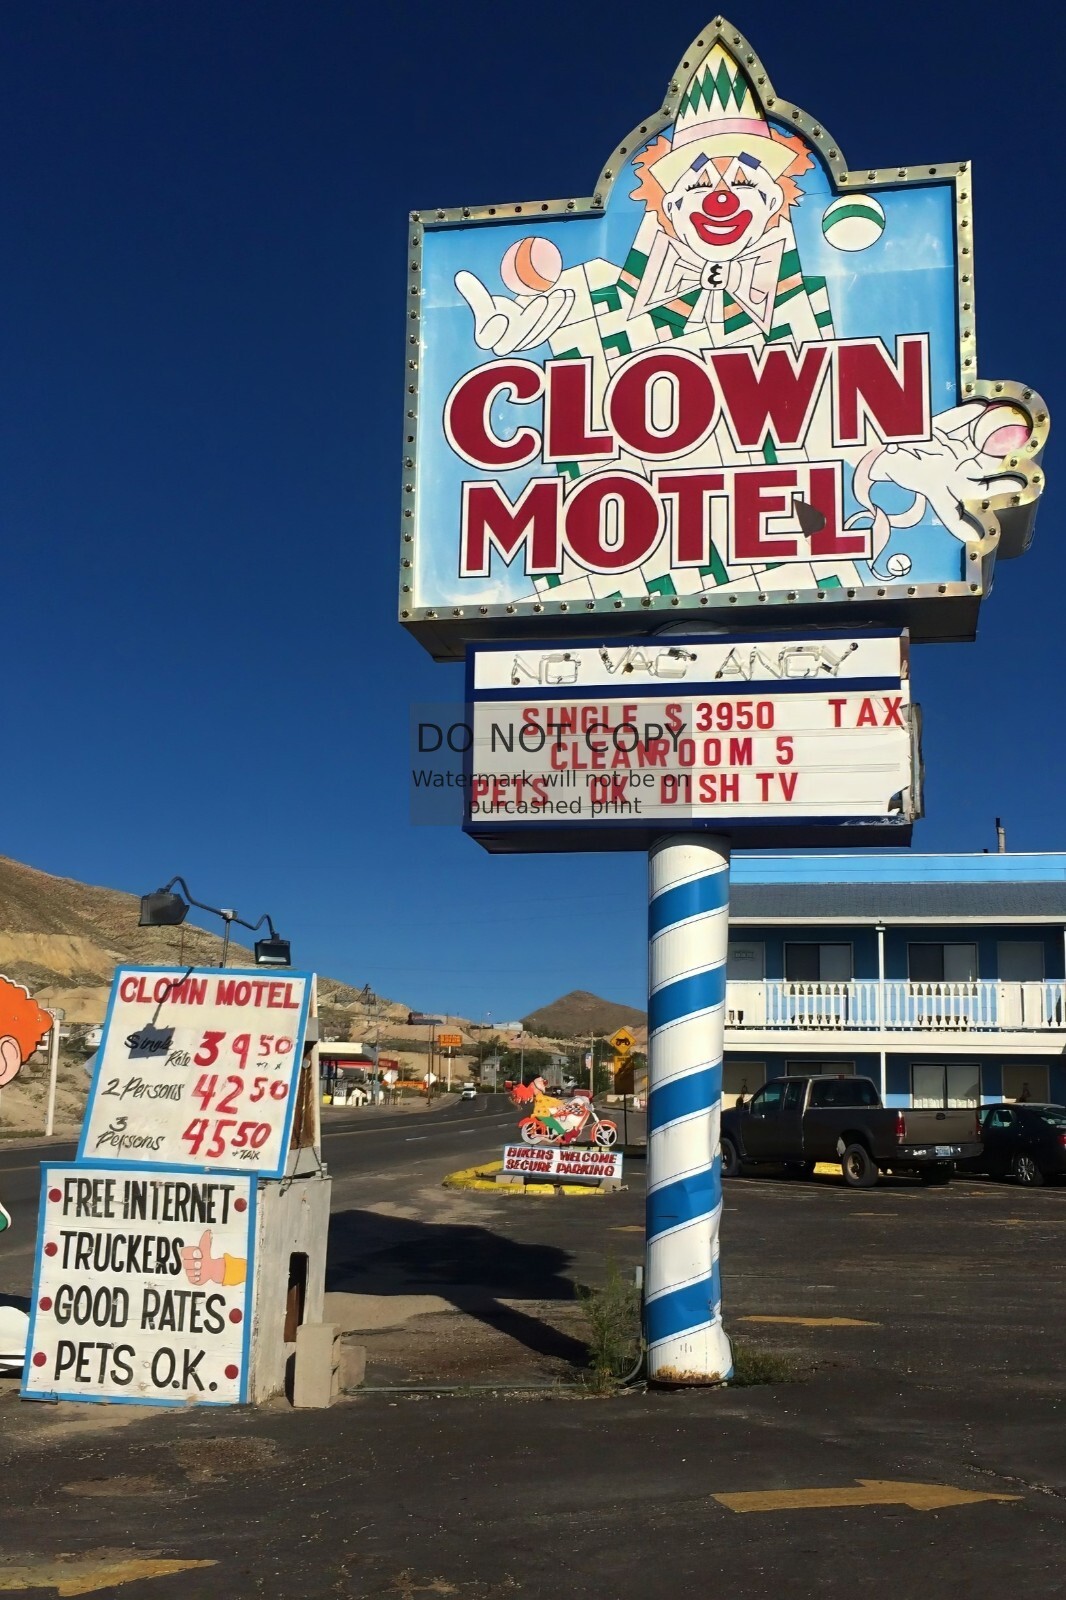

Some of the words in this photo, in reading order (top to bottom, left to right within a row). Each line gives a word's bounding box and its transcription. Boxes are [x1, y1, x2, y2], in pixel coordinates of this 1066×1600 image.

[446, 335, 930, 470] CLOWN
[460, 463, 872, 577] MOTEL
[511, 653, 581, 684] NO
[522, 704, 638, 736] SINGLE
[828, 697, 903, 728] TAX
[776, 736, 794, 765] 5
[472, 777, 549, 807] PETS
[590, 775, 628, 804] OK
[660, 773, 740, 804] DISH
[756, 772, 798, 803] TV
[120, 976, 208, 1005] CLOWN
[215, 979, 300, 1009] MOTEL
[101, 1078, 120, 1096] 2
[119, 1077, 185, 1101] Persons
[109, 1116, 128, 1132] 3
[505, 1159, 553, 1173] SECURE
[556, 1162, 615, 1177] PARKING
[506, 1147, 554, 1160] BIKERS
[560, 1150, 617, 1164] WELCOME
[62, 1178, 117, 1218] FREE
[123, 1181, 235, 1224] INTERNET
[59, 1231, 184, 1275] TRUCKERS
[54, 1284, 129, 1328] GOOD
[140, 1288, 226, 1334] RATES
[54, 1340, 136, 1386] PETS
[151, 1347, 218, 1391] O.K.
